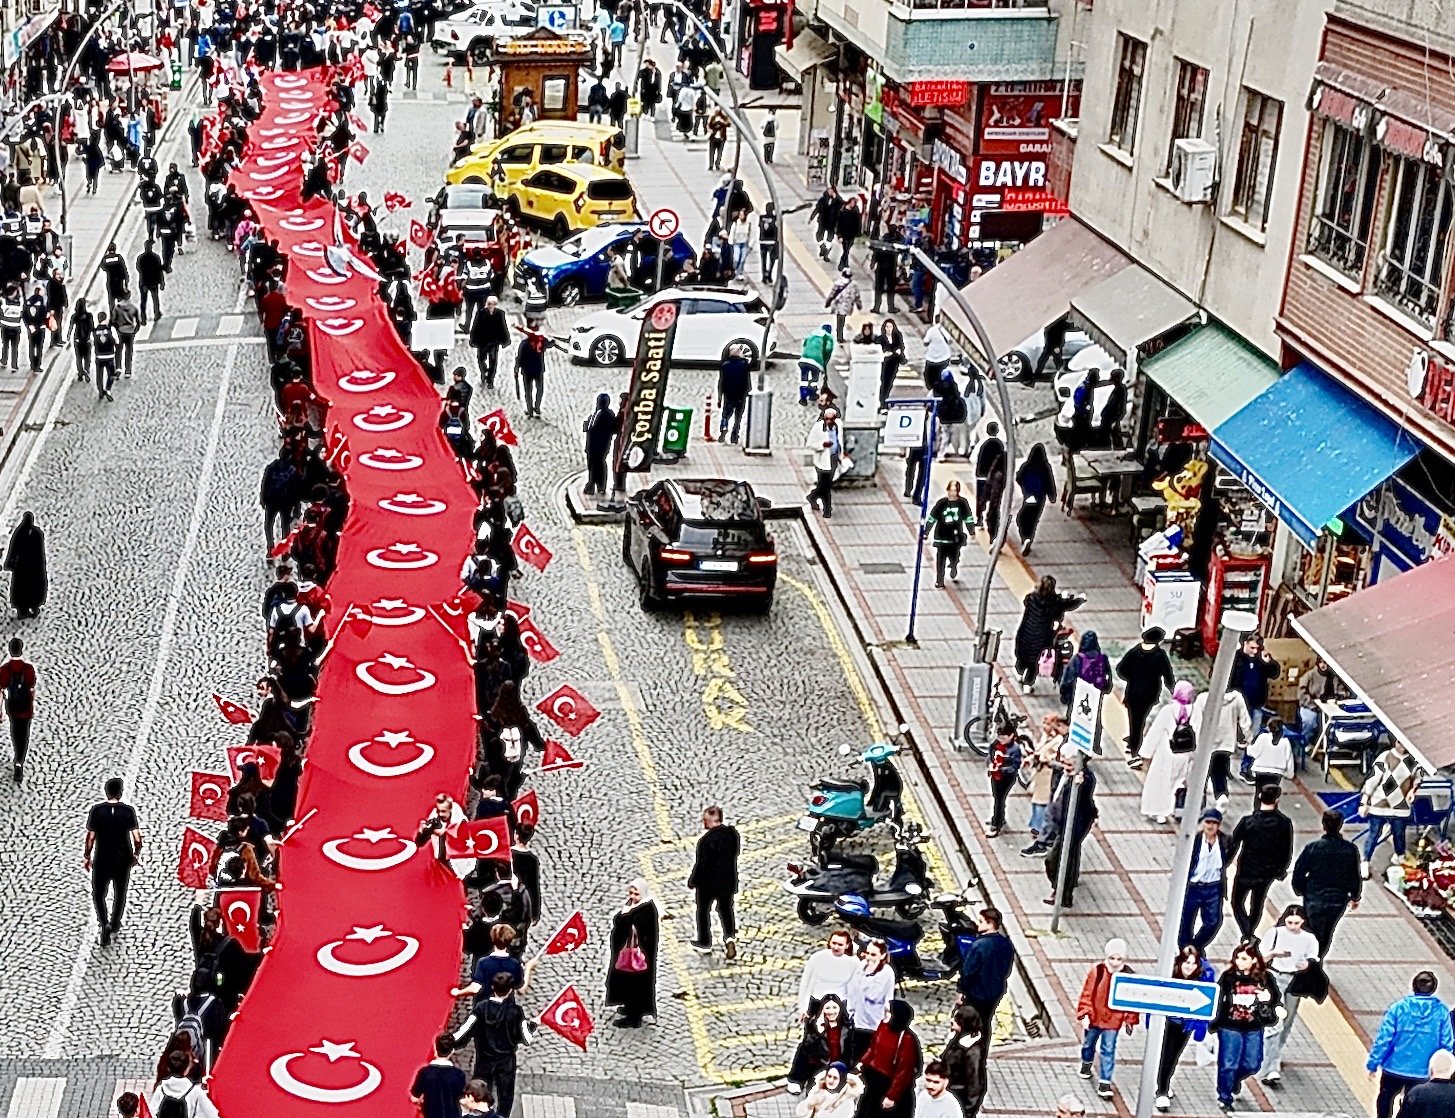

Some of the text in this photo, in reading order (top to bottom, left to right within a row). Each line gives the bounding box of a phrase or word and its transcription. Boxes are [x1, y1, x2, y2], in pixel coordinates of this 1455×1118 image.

[631, 332, 666, 443] Çorba Saati
[899, 415, 912, 428] D
